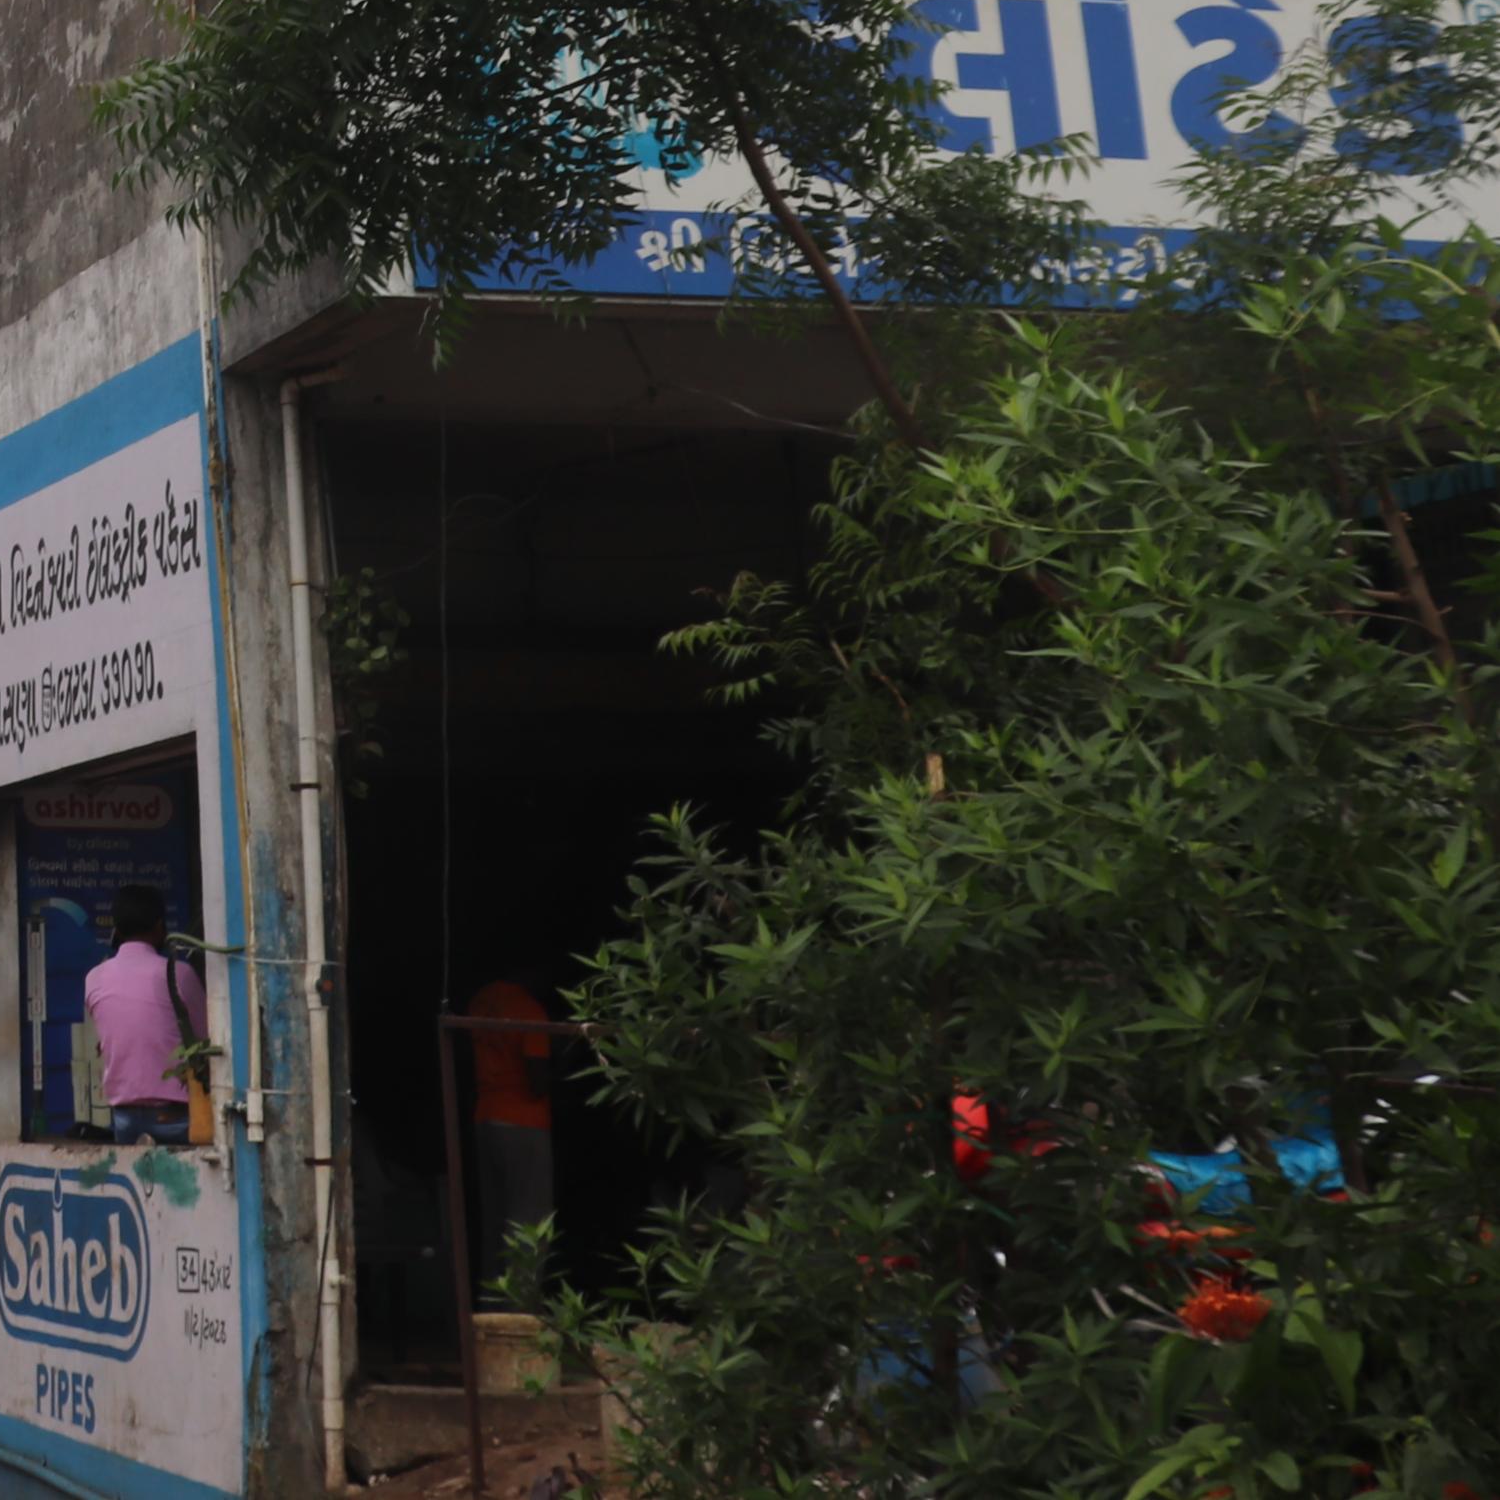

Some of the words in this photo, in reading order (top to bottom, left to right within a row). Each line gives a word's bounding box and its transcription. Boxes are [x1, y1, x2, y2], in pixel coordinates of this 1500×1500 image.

[34, 792, 162, 822] ashirvad
[4, 1202, 138, 1324] Saheb
[36, 1363, 96, 1435] PIPES
